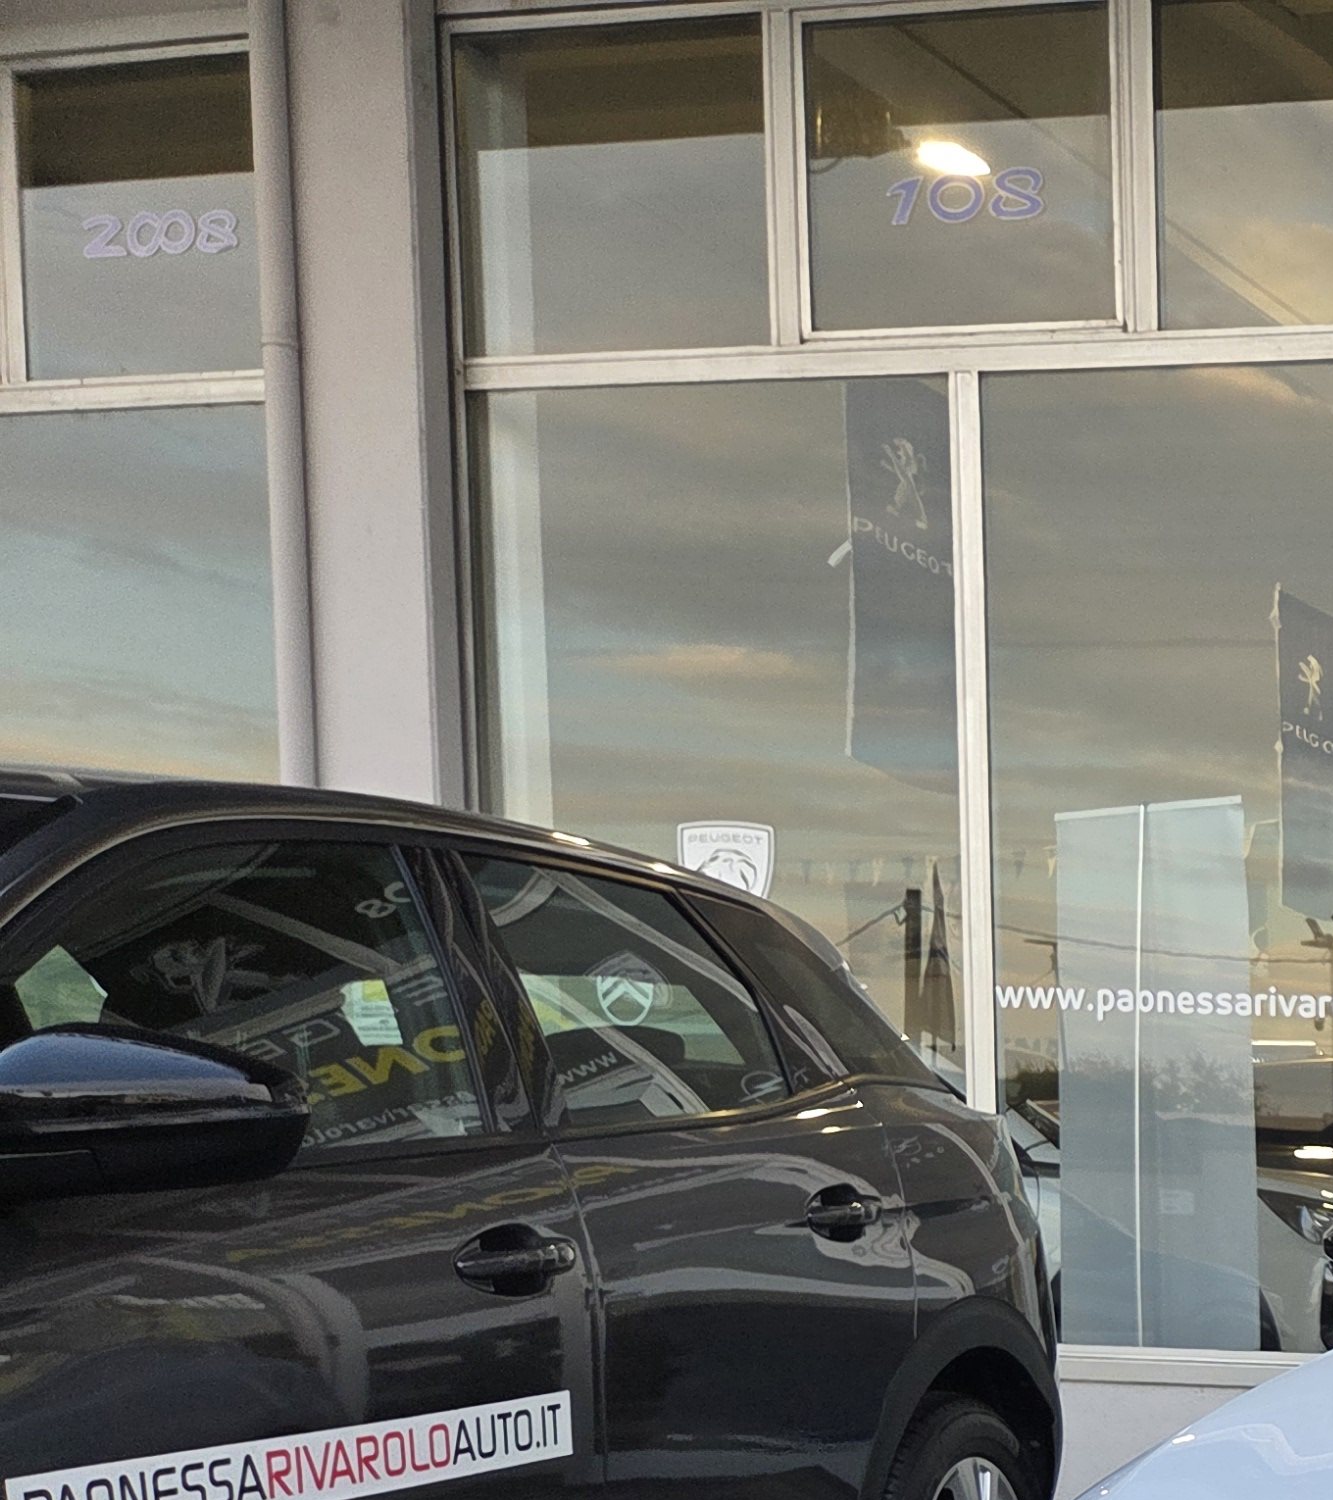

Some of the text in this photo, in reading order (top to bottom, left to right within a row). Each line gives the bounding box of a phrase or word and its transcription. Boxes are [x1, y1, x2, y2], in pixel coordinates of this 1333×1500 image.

[886, 166, 1045, 226] 108
[81, 209, 238, 259] 2008
[686, 832, 763, 845] PEUGEOT
